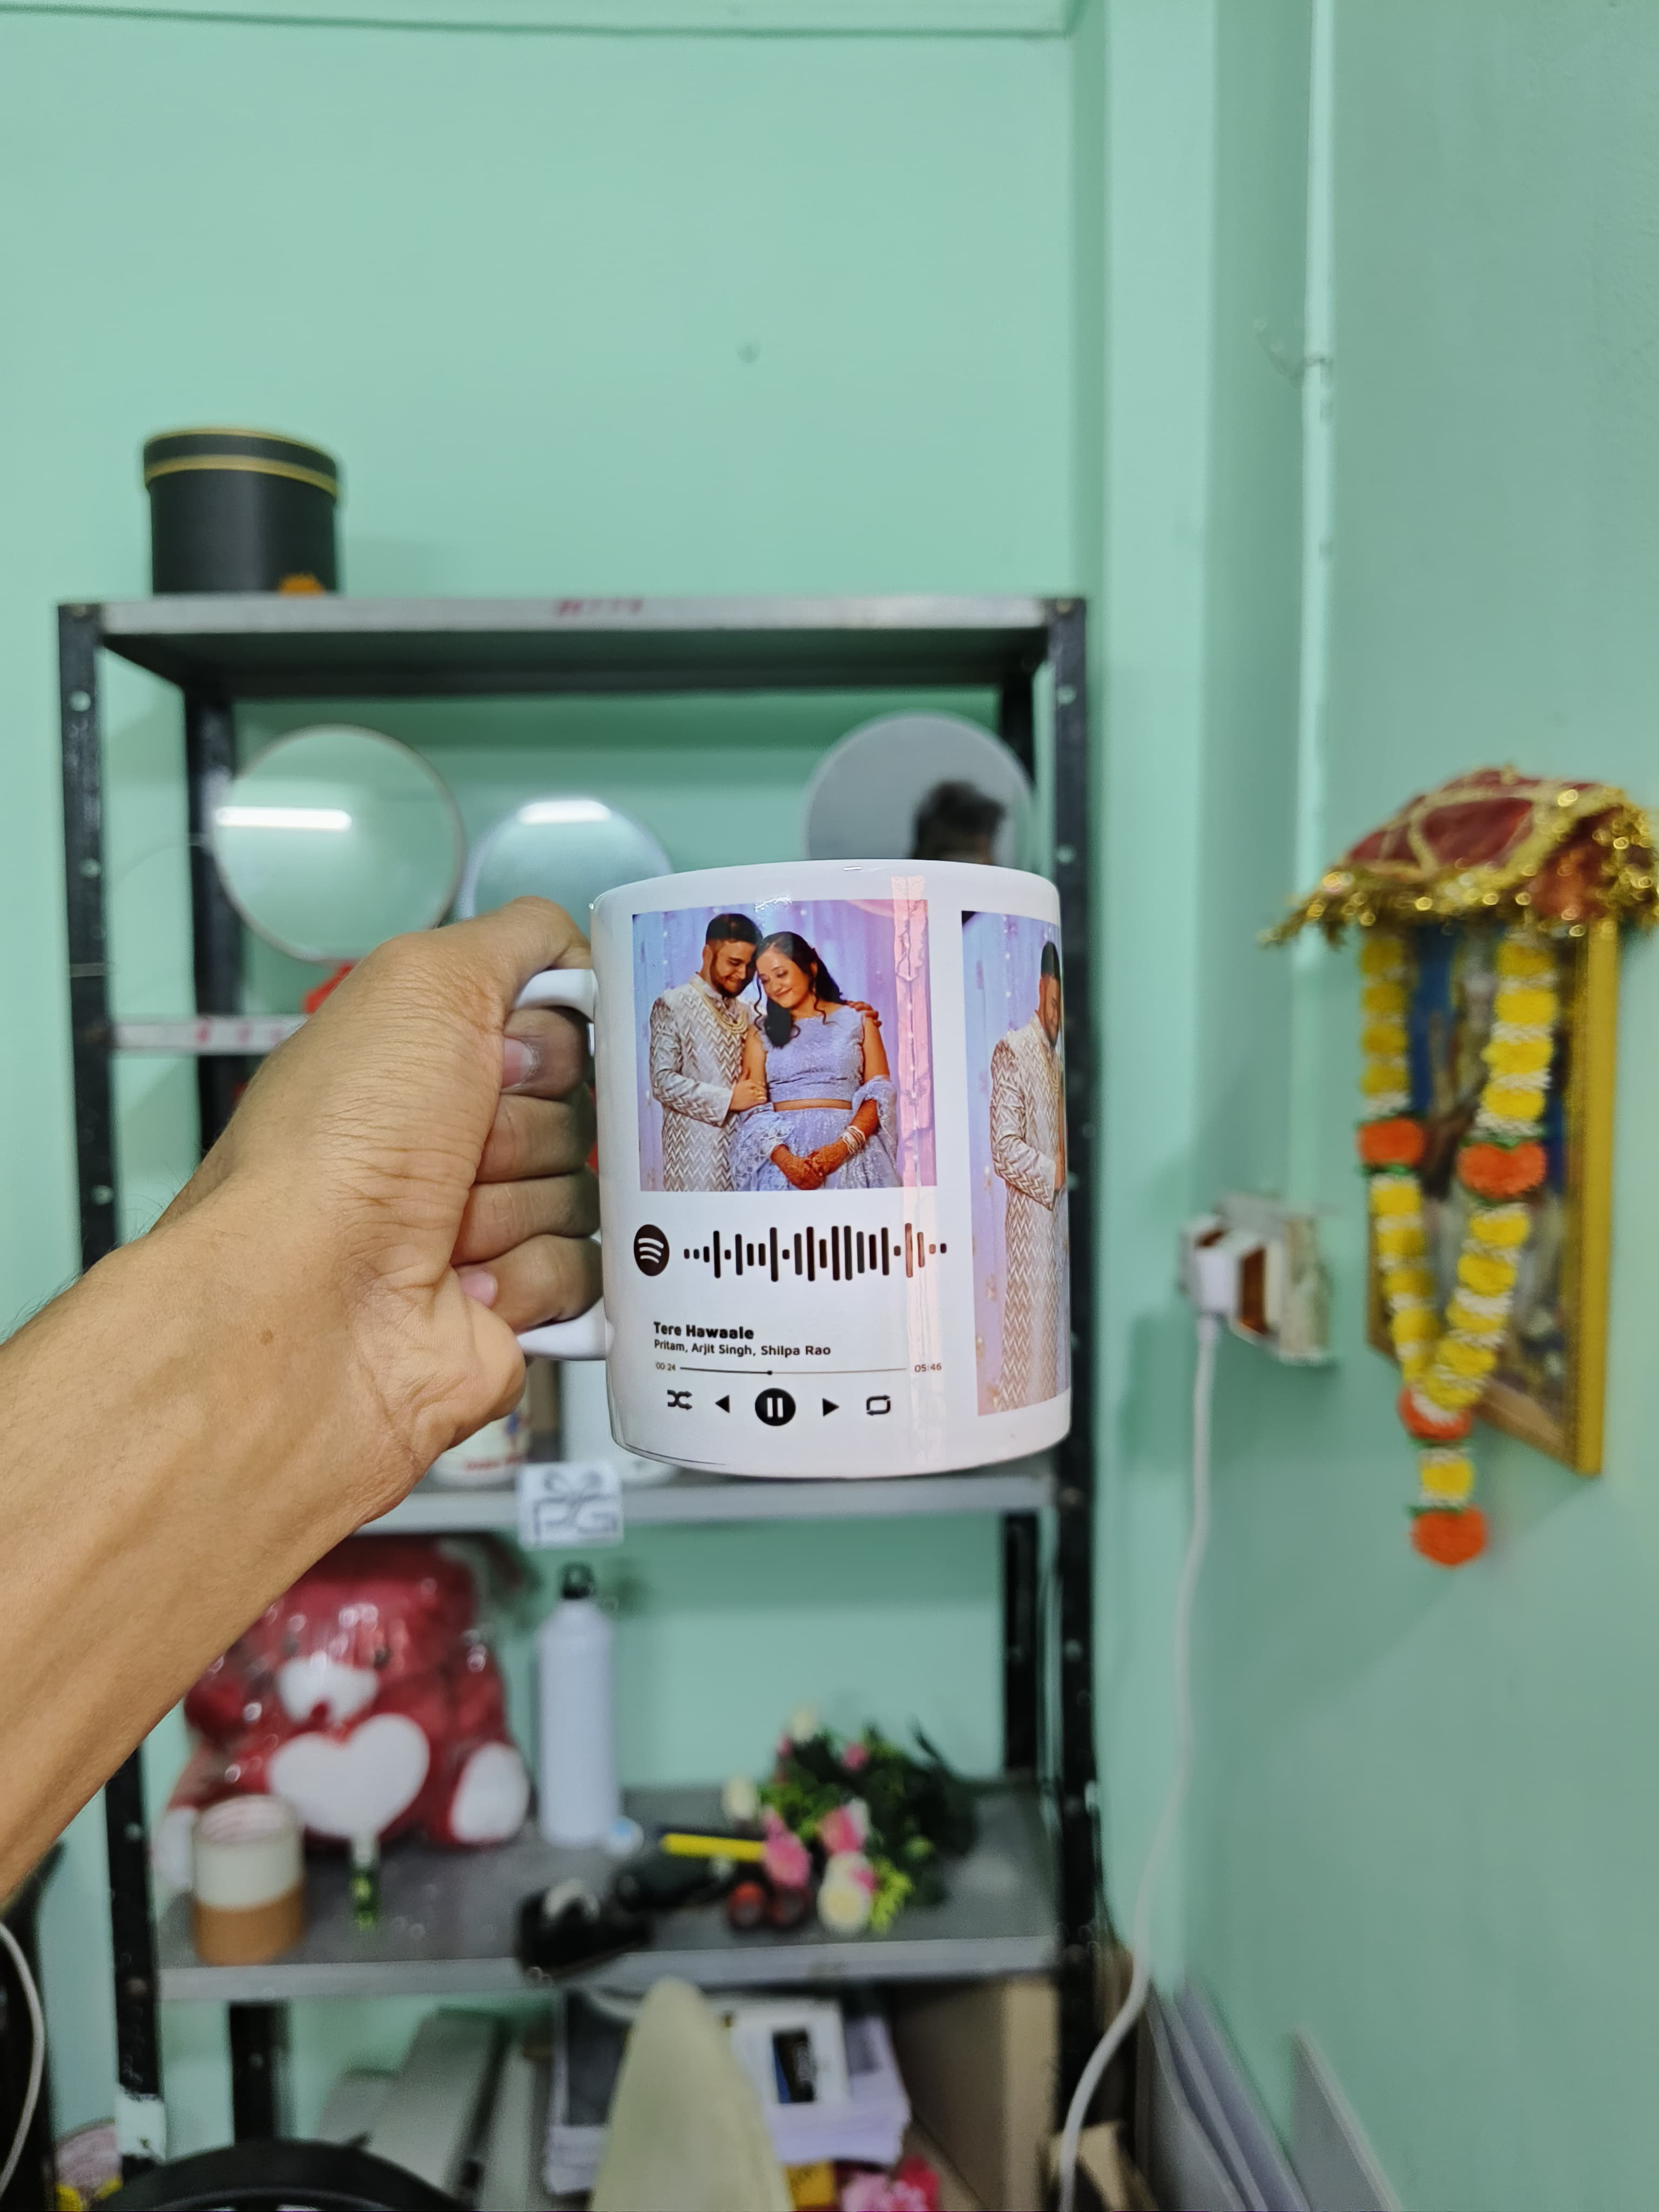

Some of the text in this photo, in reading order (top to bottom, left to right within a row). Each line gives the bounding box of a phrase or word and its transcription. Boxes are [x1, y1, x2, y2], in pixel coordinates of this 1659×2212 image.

[653, 1321, 754, 1339] Tere Hawaale
[655, 1339, 831, 1358] Pritam, Arjit Singh, Shilpa Rao
[914, 1363, 942, 1372] 05:46
